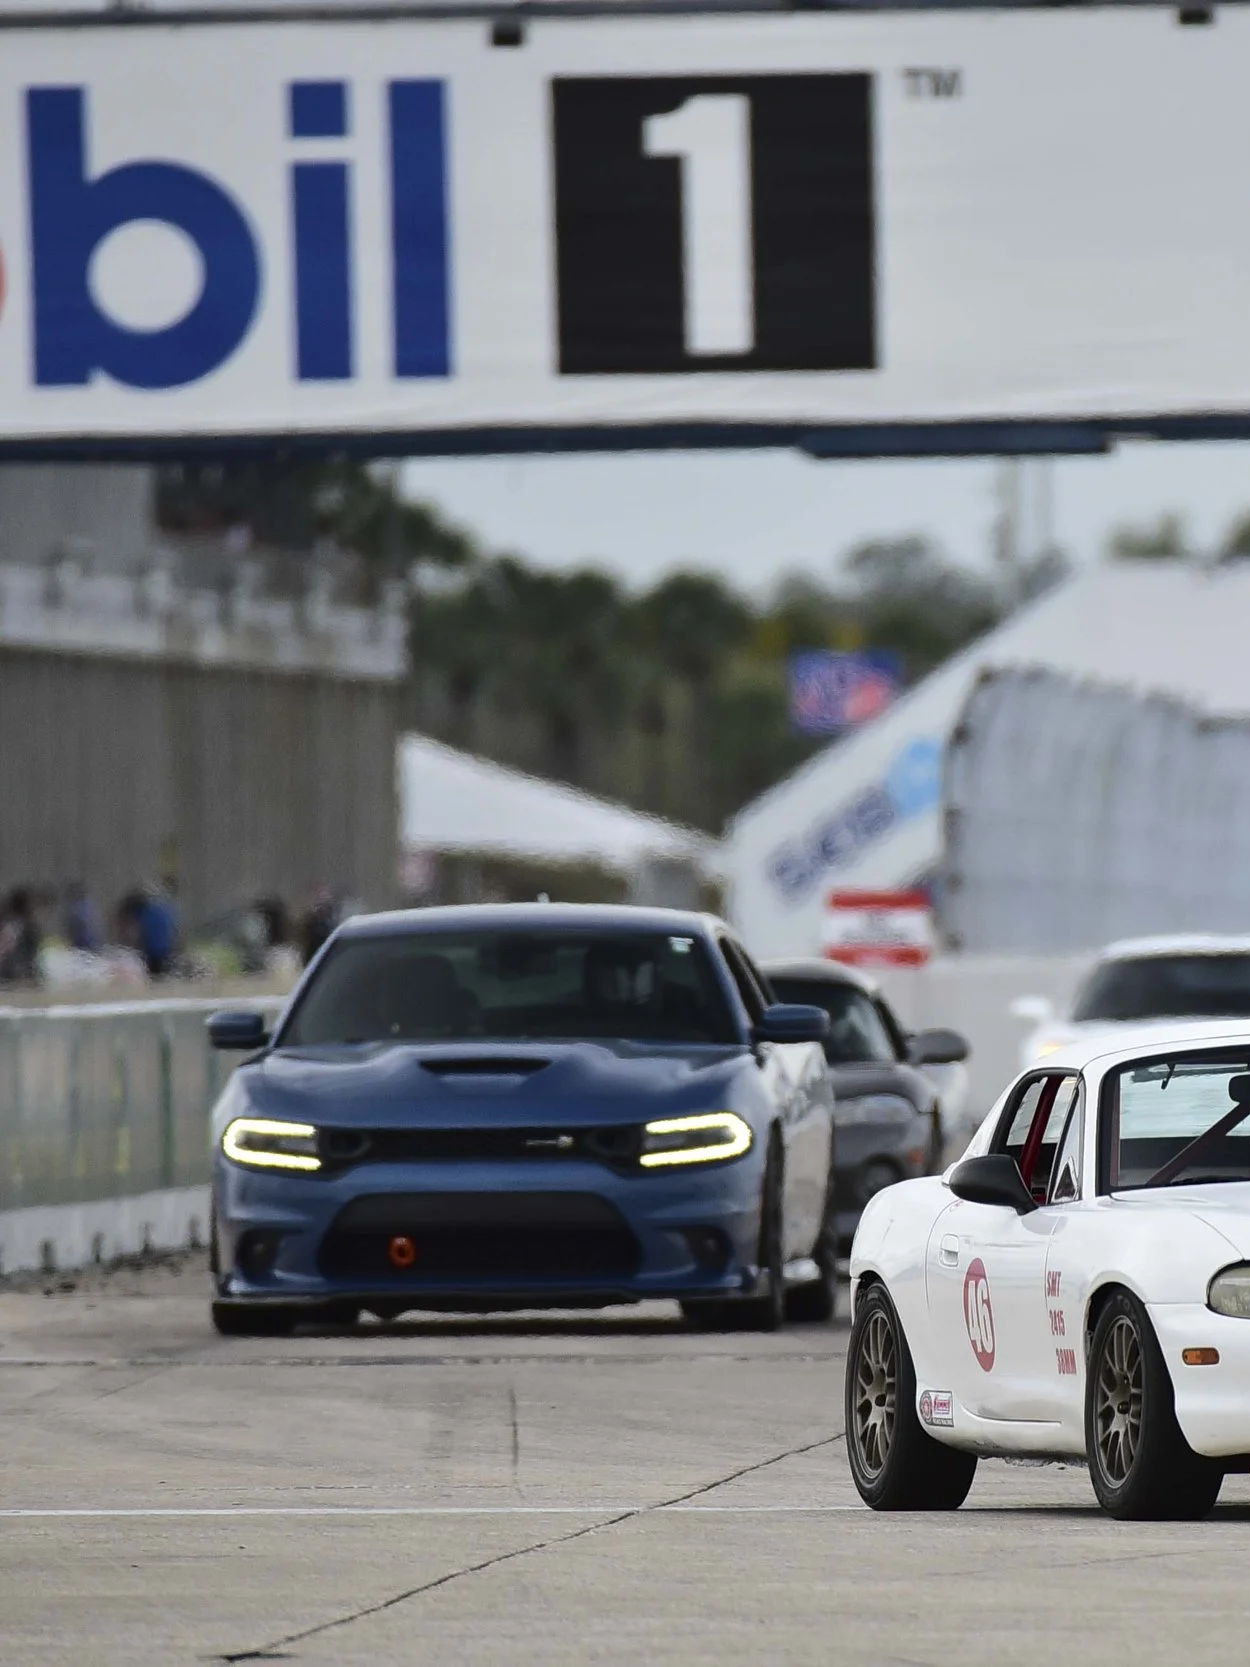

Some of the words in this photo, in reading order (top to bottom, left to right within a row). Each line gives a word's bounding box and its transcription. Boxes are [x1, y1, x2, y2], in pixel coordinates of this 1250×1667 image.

[0, 78, 453, 389] bil
[642, 94, 755, 357] 1
[903, 68, 962, 98] TM
[1047, 1271, 1061, 1297] SMT
[967, 1277, 995, 1354] 46
[1049, 1309, 1066, 1336] 2415
